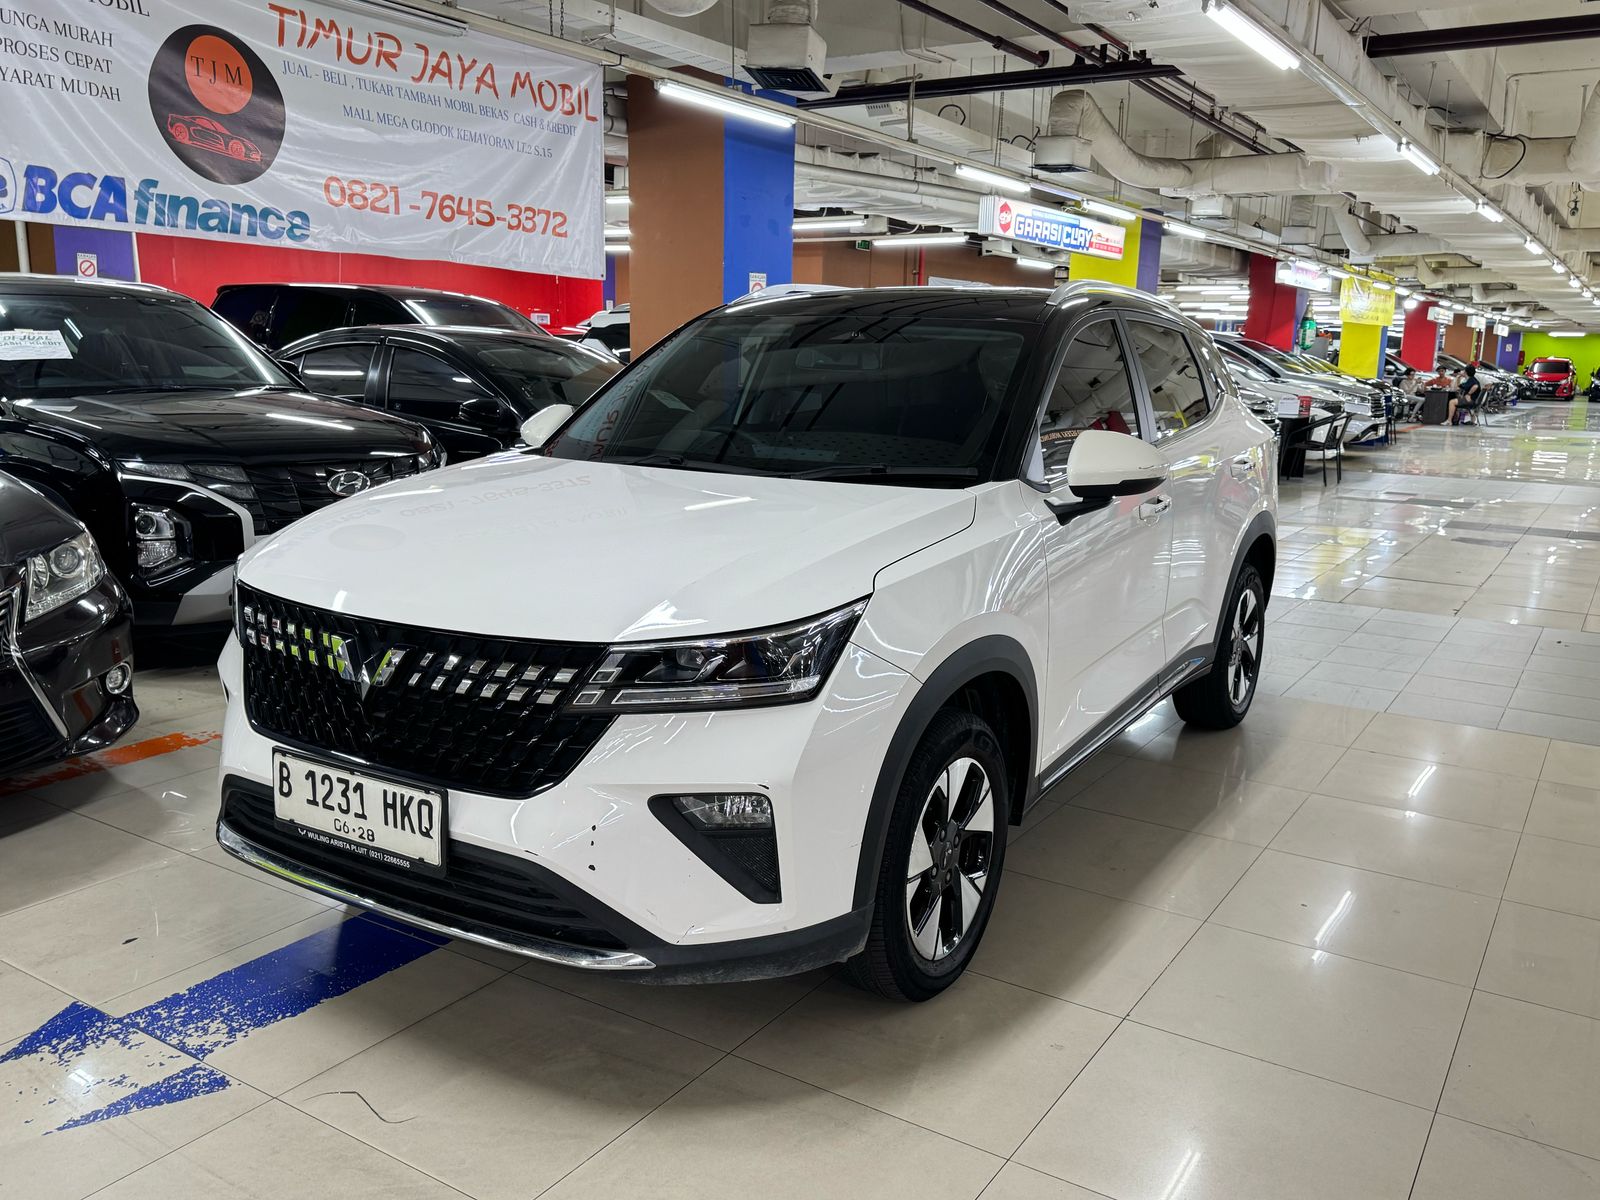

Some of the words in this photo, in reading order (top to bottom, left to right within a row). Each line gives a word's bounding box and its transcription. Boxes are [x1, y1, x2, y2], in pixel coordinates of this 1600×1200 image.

[0, 8, 50, 33] UNGA
[53, 20, 113, 48] MURAH
[89, 0, 150, 17] BIL
[64, 50, 113, 74] CEPAT
[267, 3, 403, 73] TIMUR
[410, 43, 499, 100] JAYA
[510, 71, 599, 122] MOBIL
[0, 66, 55, 89] YARAT
[60, 76, 121, 102] MUDAH
[282, 60, 312, 79] JUAL
[322, 70, 348, 87] BELI
[356, 77, 394, 97] TUKAR
[395, 86, 442, 106] TAMBAH
[444, 97, 478, 115] MOBIL
[479, 104, 510, 121] BEKAS
[513, 113, 538, 129] CASH
[539, 118, 545, 130] &
[546, 121, 578, 137] KREDIT
[343, 104, 374, 122] MALL
[376, 111, 409, 130] MEGA
[411, 118, 455, 139] GLODOK
[456, 128, 514, 151] KEMAYORAN
[533, 144, 553, 158] S.15
[22, 164, 129, 223] BCA
[134, 178, 311, 243] finance
[323, 176, 401, 216] 0821
[1015, 214, 1061, 244] GARASI
[278, 761, 293, 798] B
[304, 769, 368, 821] 1231
[382, 788, 434, 840] HKQ
[307, 831, 330, 845] WULING
[330, 838, 351, 850] ARISTA
[351, 845, 368, 855] PLUIT
[369, 849, 384, 861] (021)
